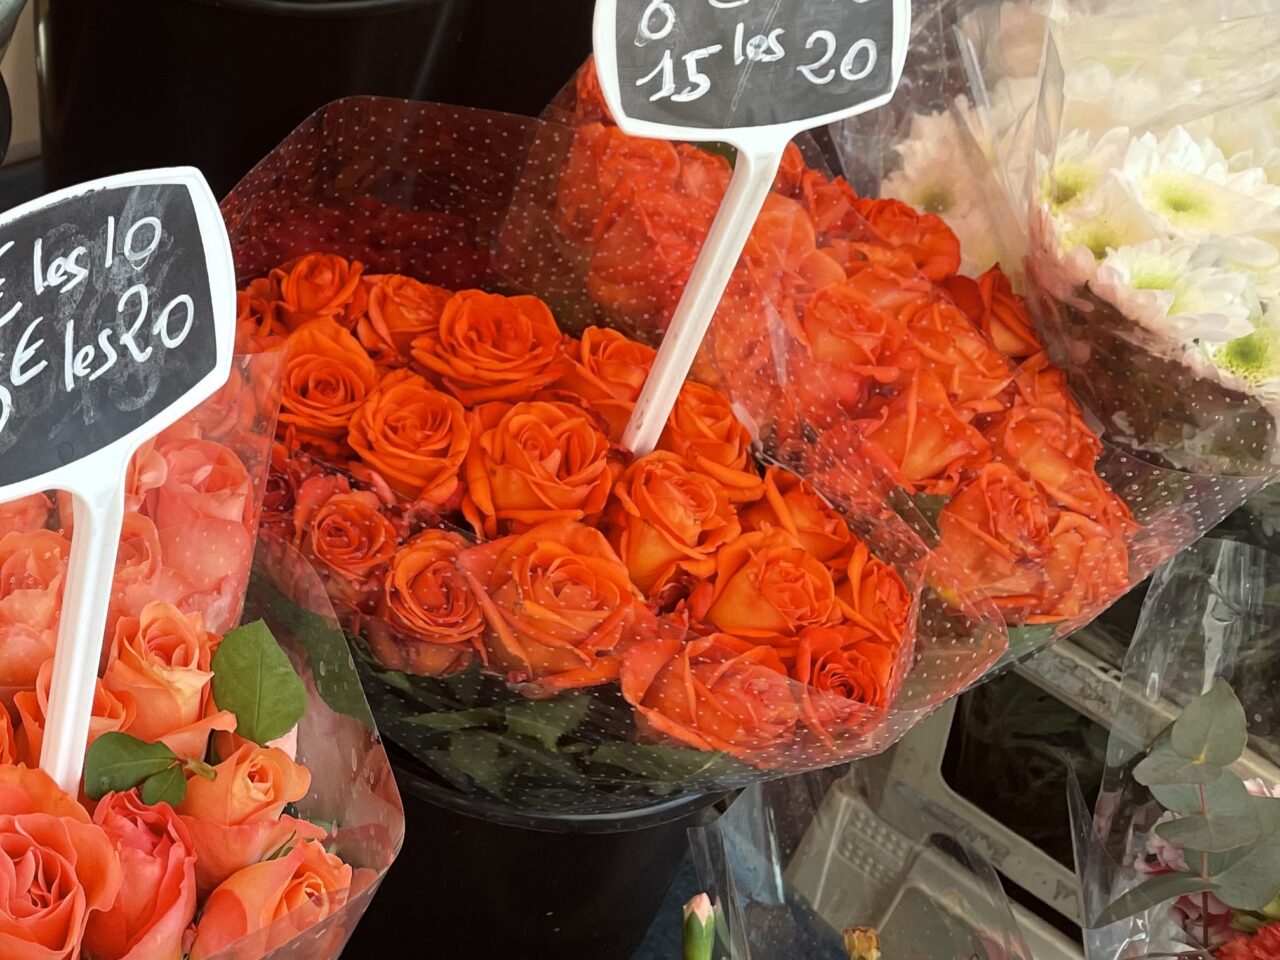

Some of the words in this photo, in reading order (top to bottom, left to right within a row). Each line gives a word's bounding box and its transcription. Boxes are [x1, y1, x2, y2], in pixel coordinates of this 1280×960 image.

[635, 44, 723, 102] 15
[796, 29, 878, 85] 20
[33, 237, 88, 296] les
[104, 215, 163, 269] 10
[64, 318, 118, 392] les
[118, 283, 195, 363] 20
